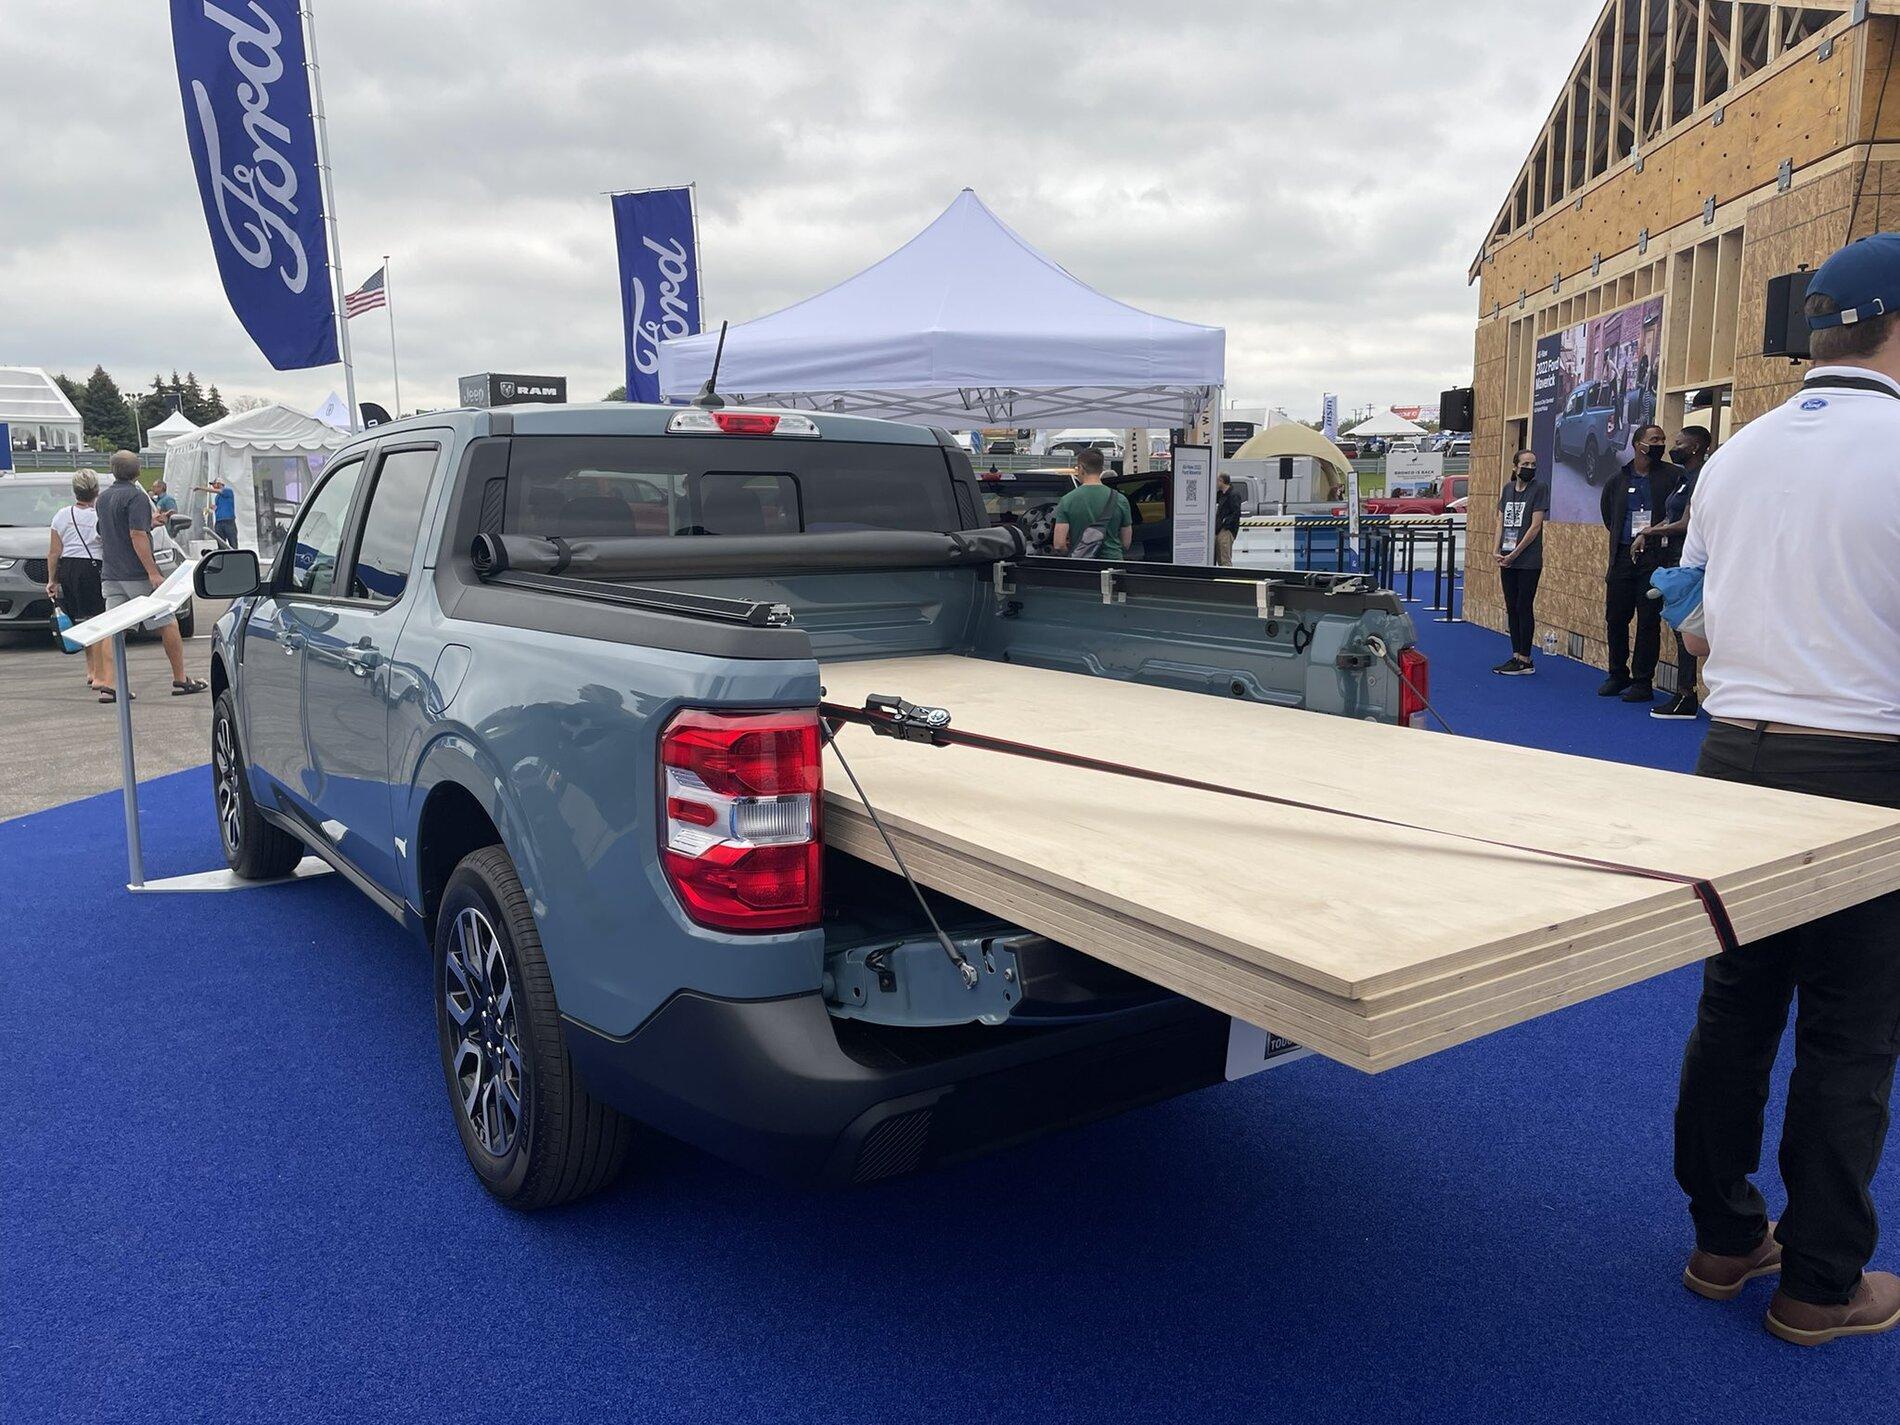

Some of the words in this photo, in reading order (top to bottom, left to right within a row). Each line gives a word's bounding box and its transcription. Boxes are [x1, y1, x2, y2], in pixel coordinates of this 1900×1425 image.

[191, 0, 309, 294] Ford
[632, 235, 690, 375] Ford
[1535, 373, 1555, 390] Maverick
[463, 387, 484, 404] Jeep
[517, 386, 557, 396] RAM
